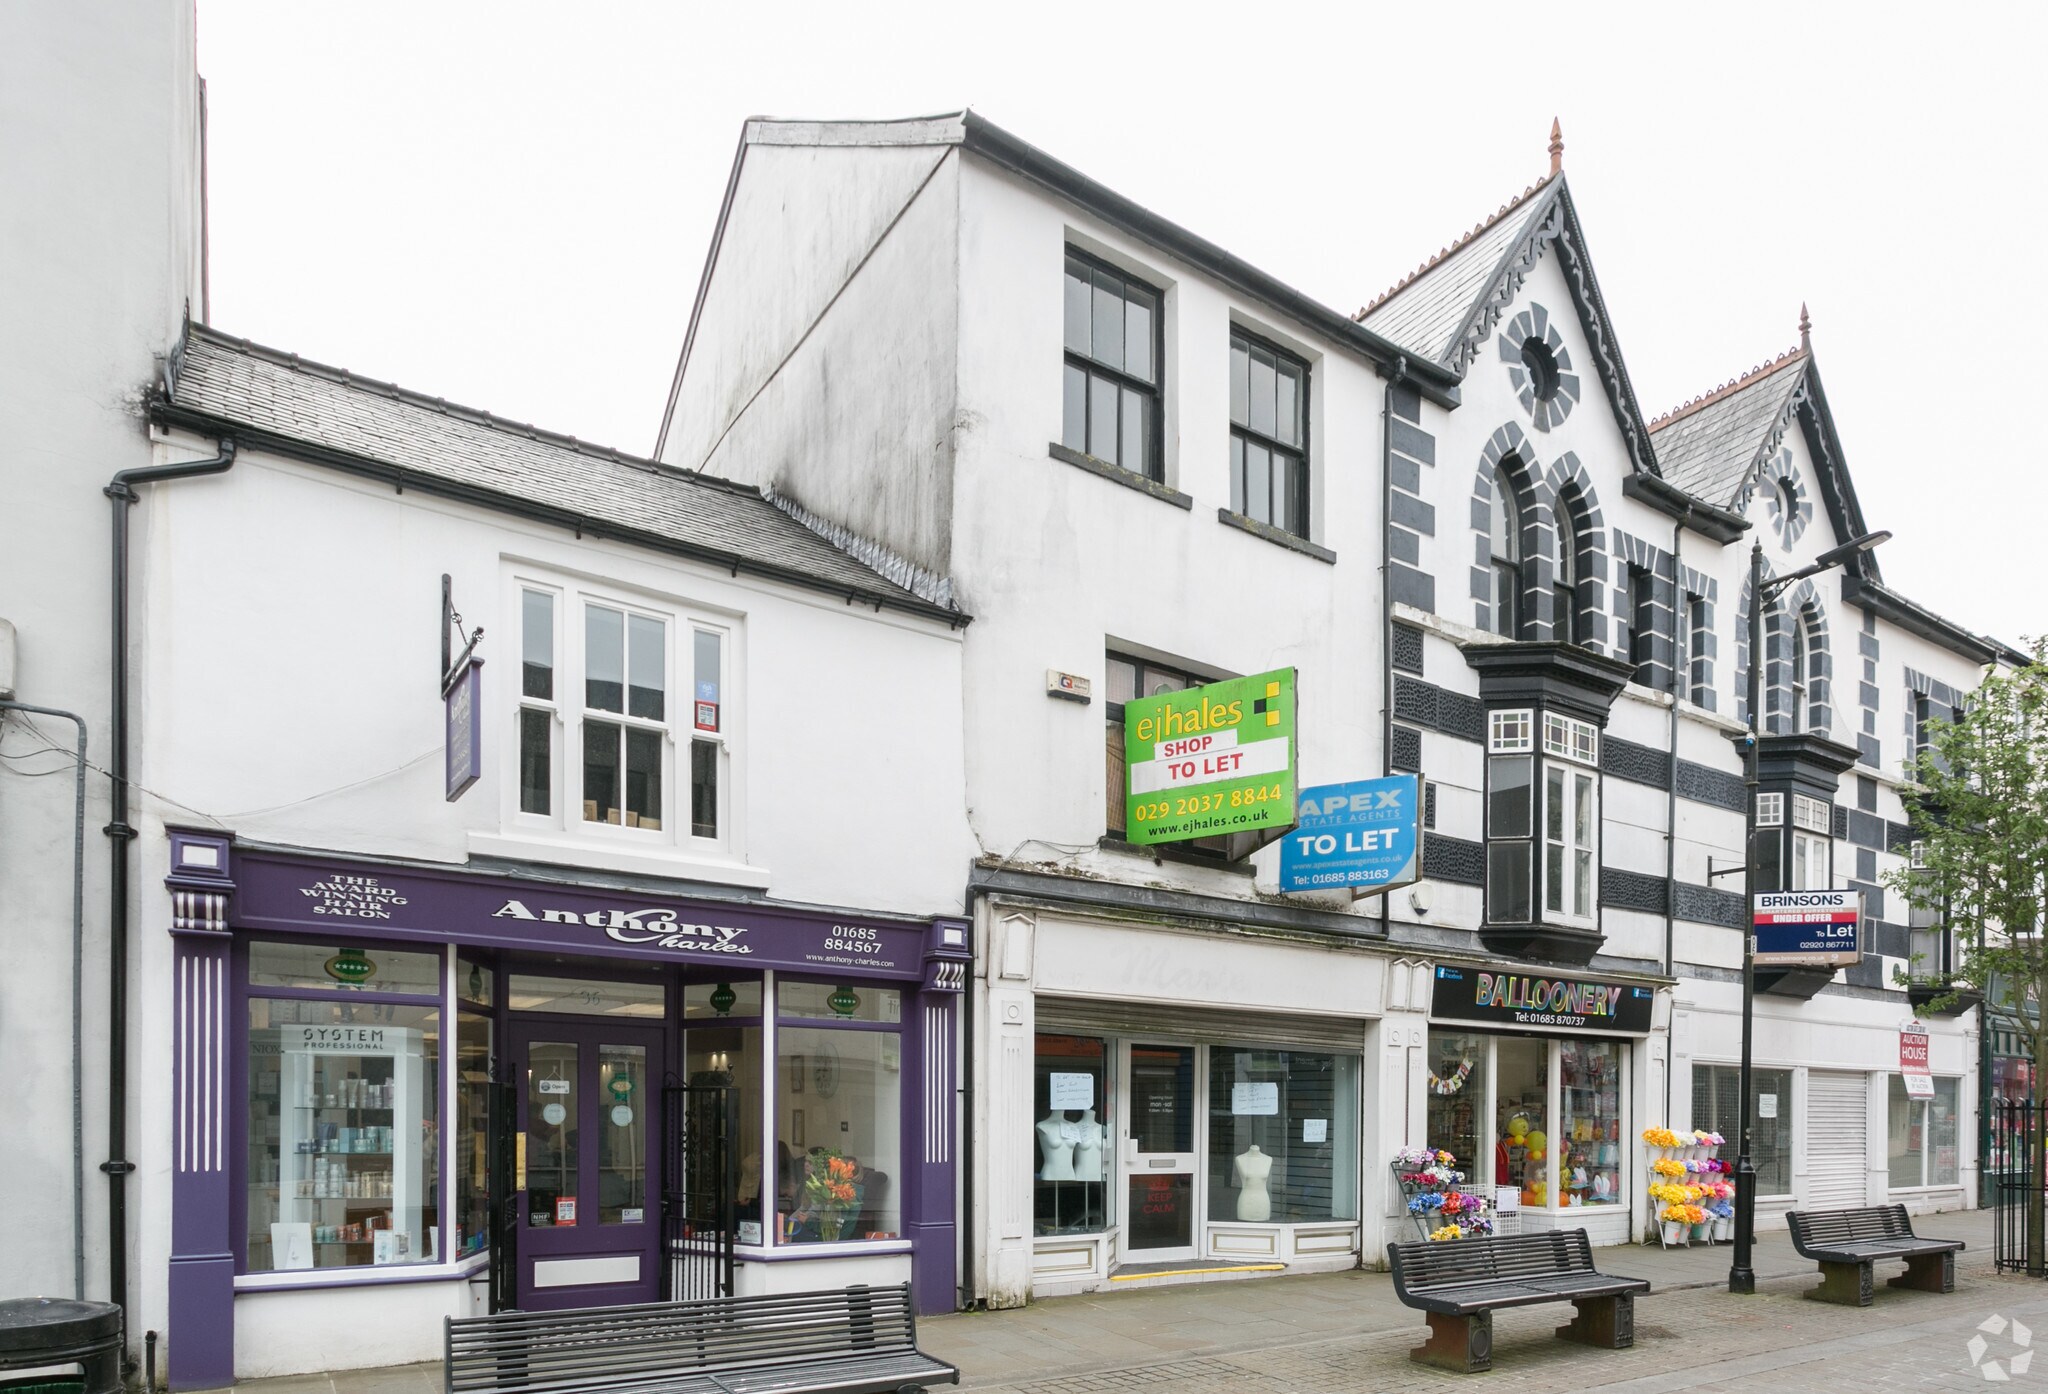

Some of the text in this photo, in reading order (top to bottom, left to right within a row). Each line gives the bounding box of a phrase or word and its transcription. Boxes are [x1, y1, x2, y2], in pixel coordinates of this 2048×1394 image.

[1137, 697, 1243, 743] ejhales
[1164, 736, 1213, 757] SHOP
[1168, 753, 1244, 780] TO LET
[1136, 784, 1282, 822] 029 2037 8844
[1299, 789, 1402, 817] APEX
[1148, 809, 1268, 836] www.ejhales.co.uk
[1350, 809, 1400, 822] AGENTS
[1297, 828, 1399, 856] TO LET
[1292, 855, 1402, 870] www.apexestateagents.co.uk
[330, 875, 378, 886] THE
[1294, 869, 1389, 885] Tel: 01685 883163
[312, 882, 397, 896] AWARD
[299, 888, 408, 905] WINNING
[1761, 895, 1844, 907] BRINSONS
[324, 899, 383, 910] HAIR
[313, 906, 391, 919] SALON
[1773, 913, 1832, 923] UNDER OFFER
[491, 900, 748, 942] Anthony
[832, 925, 877, 940] 01685
[1827, 924, 1854, 937] Let
[824, 938, 882, 953] 884567
[1800, 941, 1824, 949] 02920
[806, 954, 894, 967] www.anthony-charles.com
[1476, 973, 1622, 1016] BALLOONERY
[1515, 1012, 1586, 1026] Tel: 01685 870737
[303, 1028, 383, 1042] SYSTEM
[1902, 1034, 1927, 1045] AUCTION
[304, 1042, 384, 1050] PROFESSIONAL
[1902, 1047, 1926, 1060] HOUSE
[1148, 1193, 1173, 1202] KEEP
[1143, 1203, 1175, 1214] CALM
